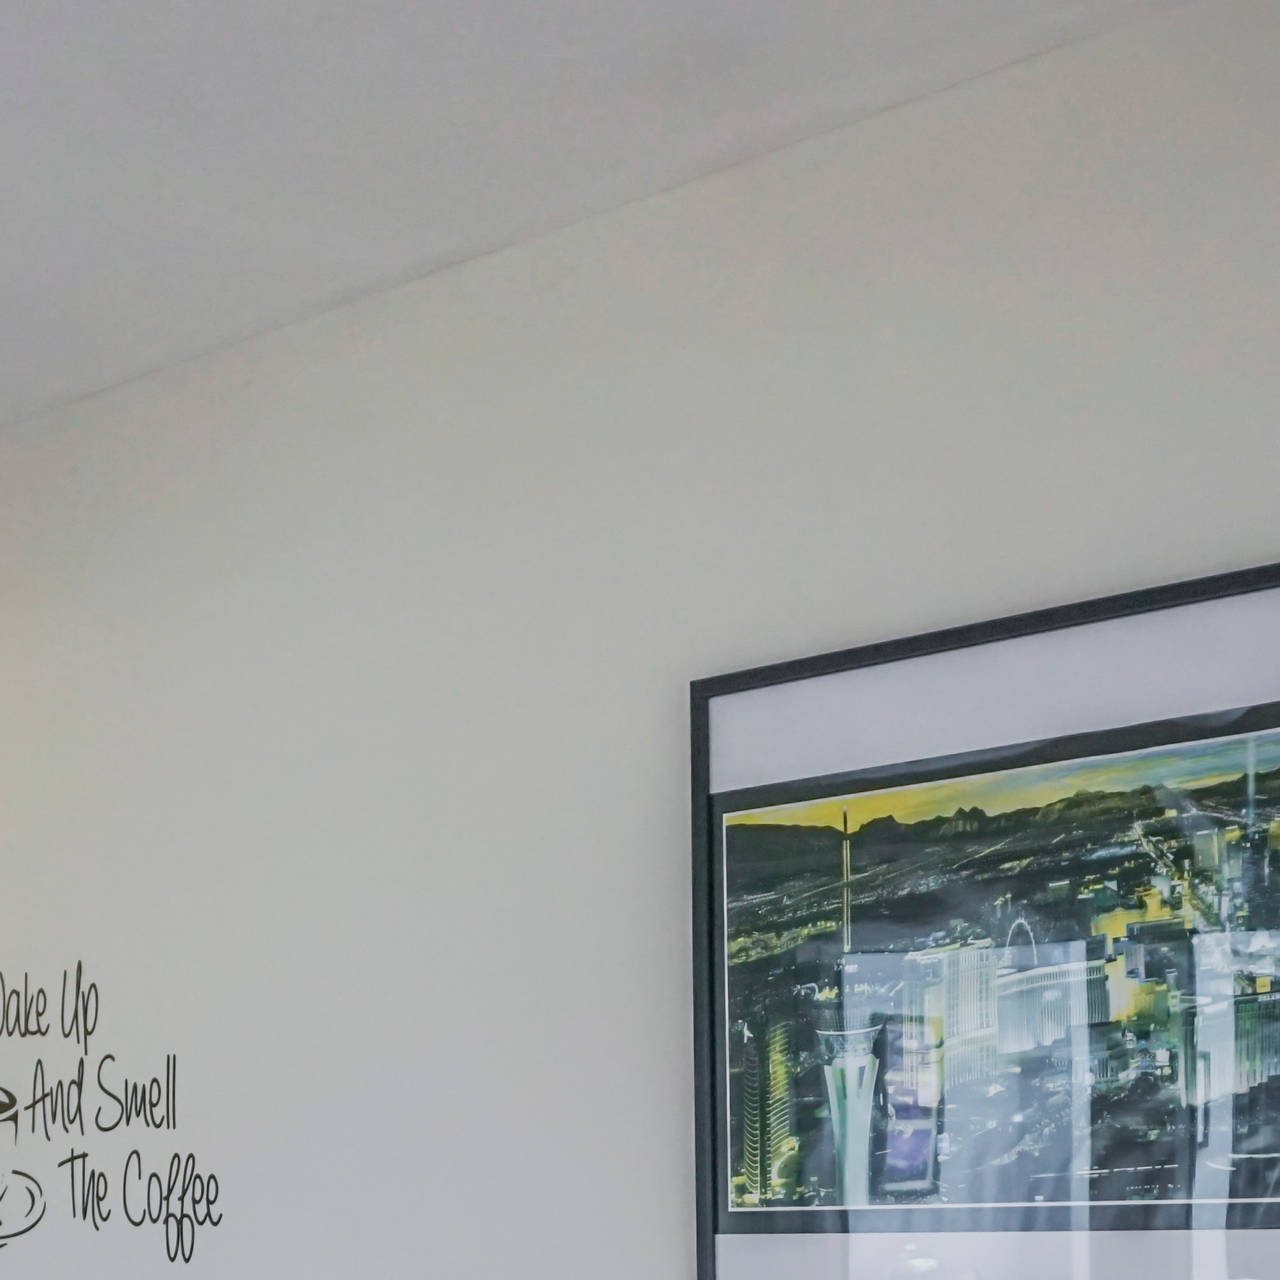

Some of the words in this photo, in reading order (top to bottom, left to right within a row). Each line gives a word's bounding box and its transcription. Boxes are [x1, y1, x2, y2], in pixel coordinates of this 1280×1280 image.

[61, 960, 99, 1056] Up
[24, 1056, 85, 1142] And
[95, 1054, 176, 1132] Smell
[57, 1148, 112, 1231] The
[123, 1149, 223, 1264] Coffee
